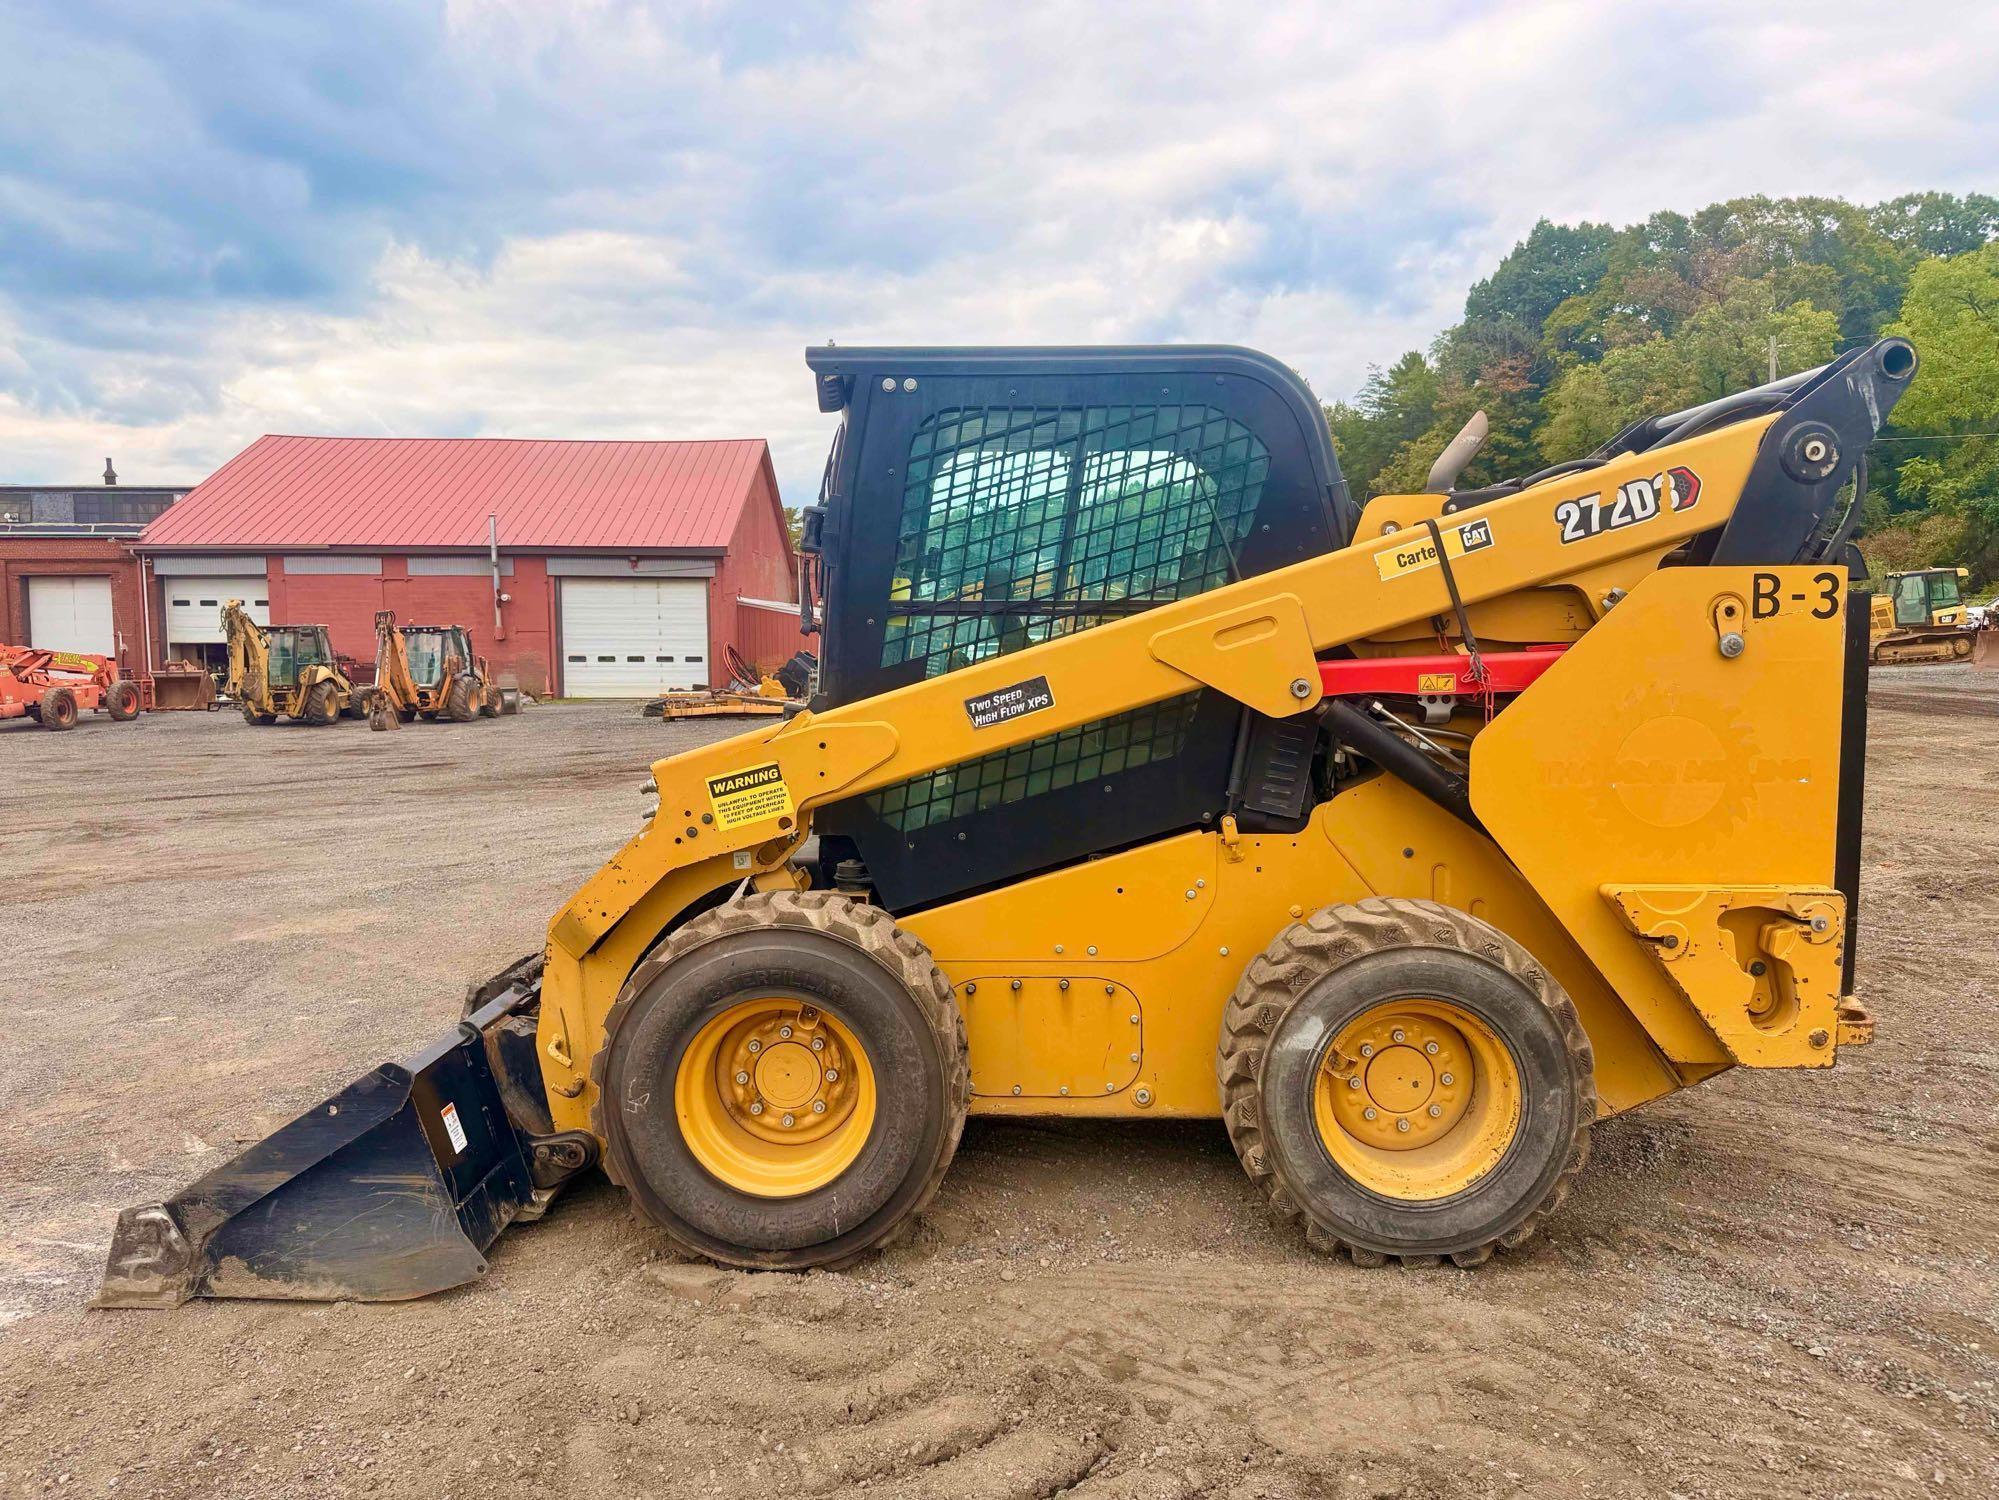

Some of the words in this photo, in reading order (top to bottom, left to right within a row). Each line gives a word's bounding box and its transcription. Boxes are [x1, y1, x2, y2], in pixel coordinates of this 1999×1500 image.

[1396, 546, 1438, 568] Carte
[1462, 527, 1487, 547] CAT
[1027, 694, 1049, 710] XPS
[713, 768, 779, 794] WARNING
[717, 796, 748, 808] UNLAWFUL
[758, 787, 784, 797] OPERATE
[718, 806, 732, 814] THIS
[732, 798, 765, 810] EQUIPMENT
[765, 792, 787, 801] WITHIN
[731, 808, 745, 816] FEET
[754, 799, 785, 810] OVERHEAD
[726, 816, 741, 824] HIGH
[742, 810, 767, 819] VOLTAGE
[768, 805, 784, 813] LINES
